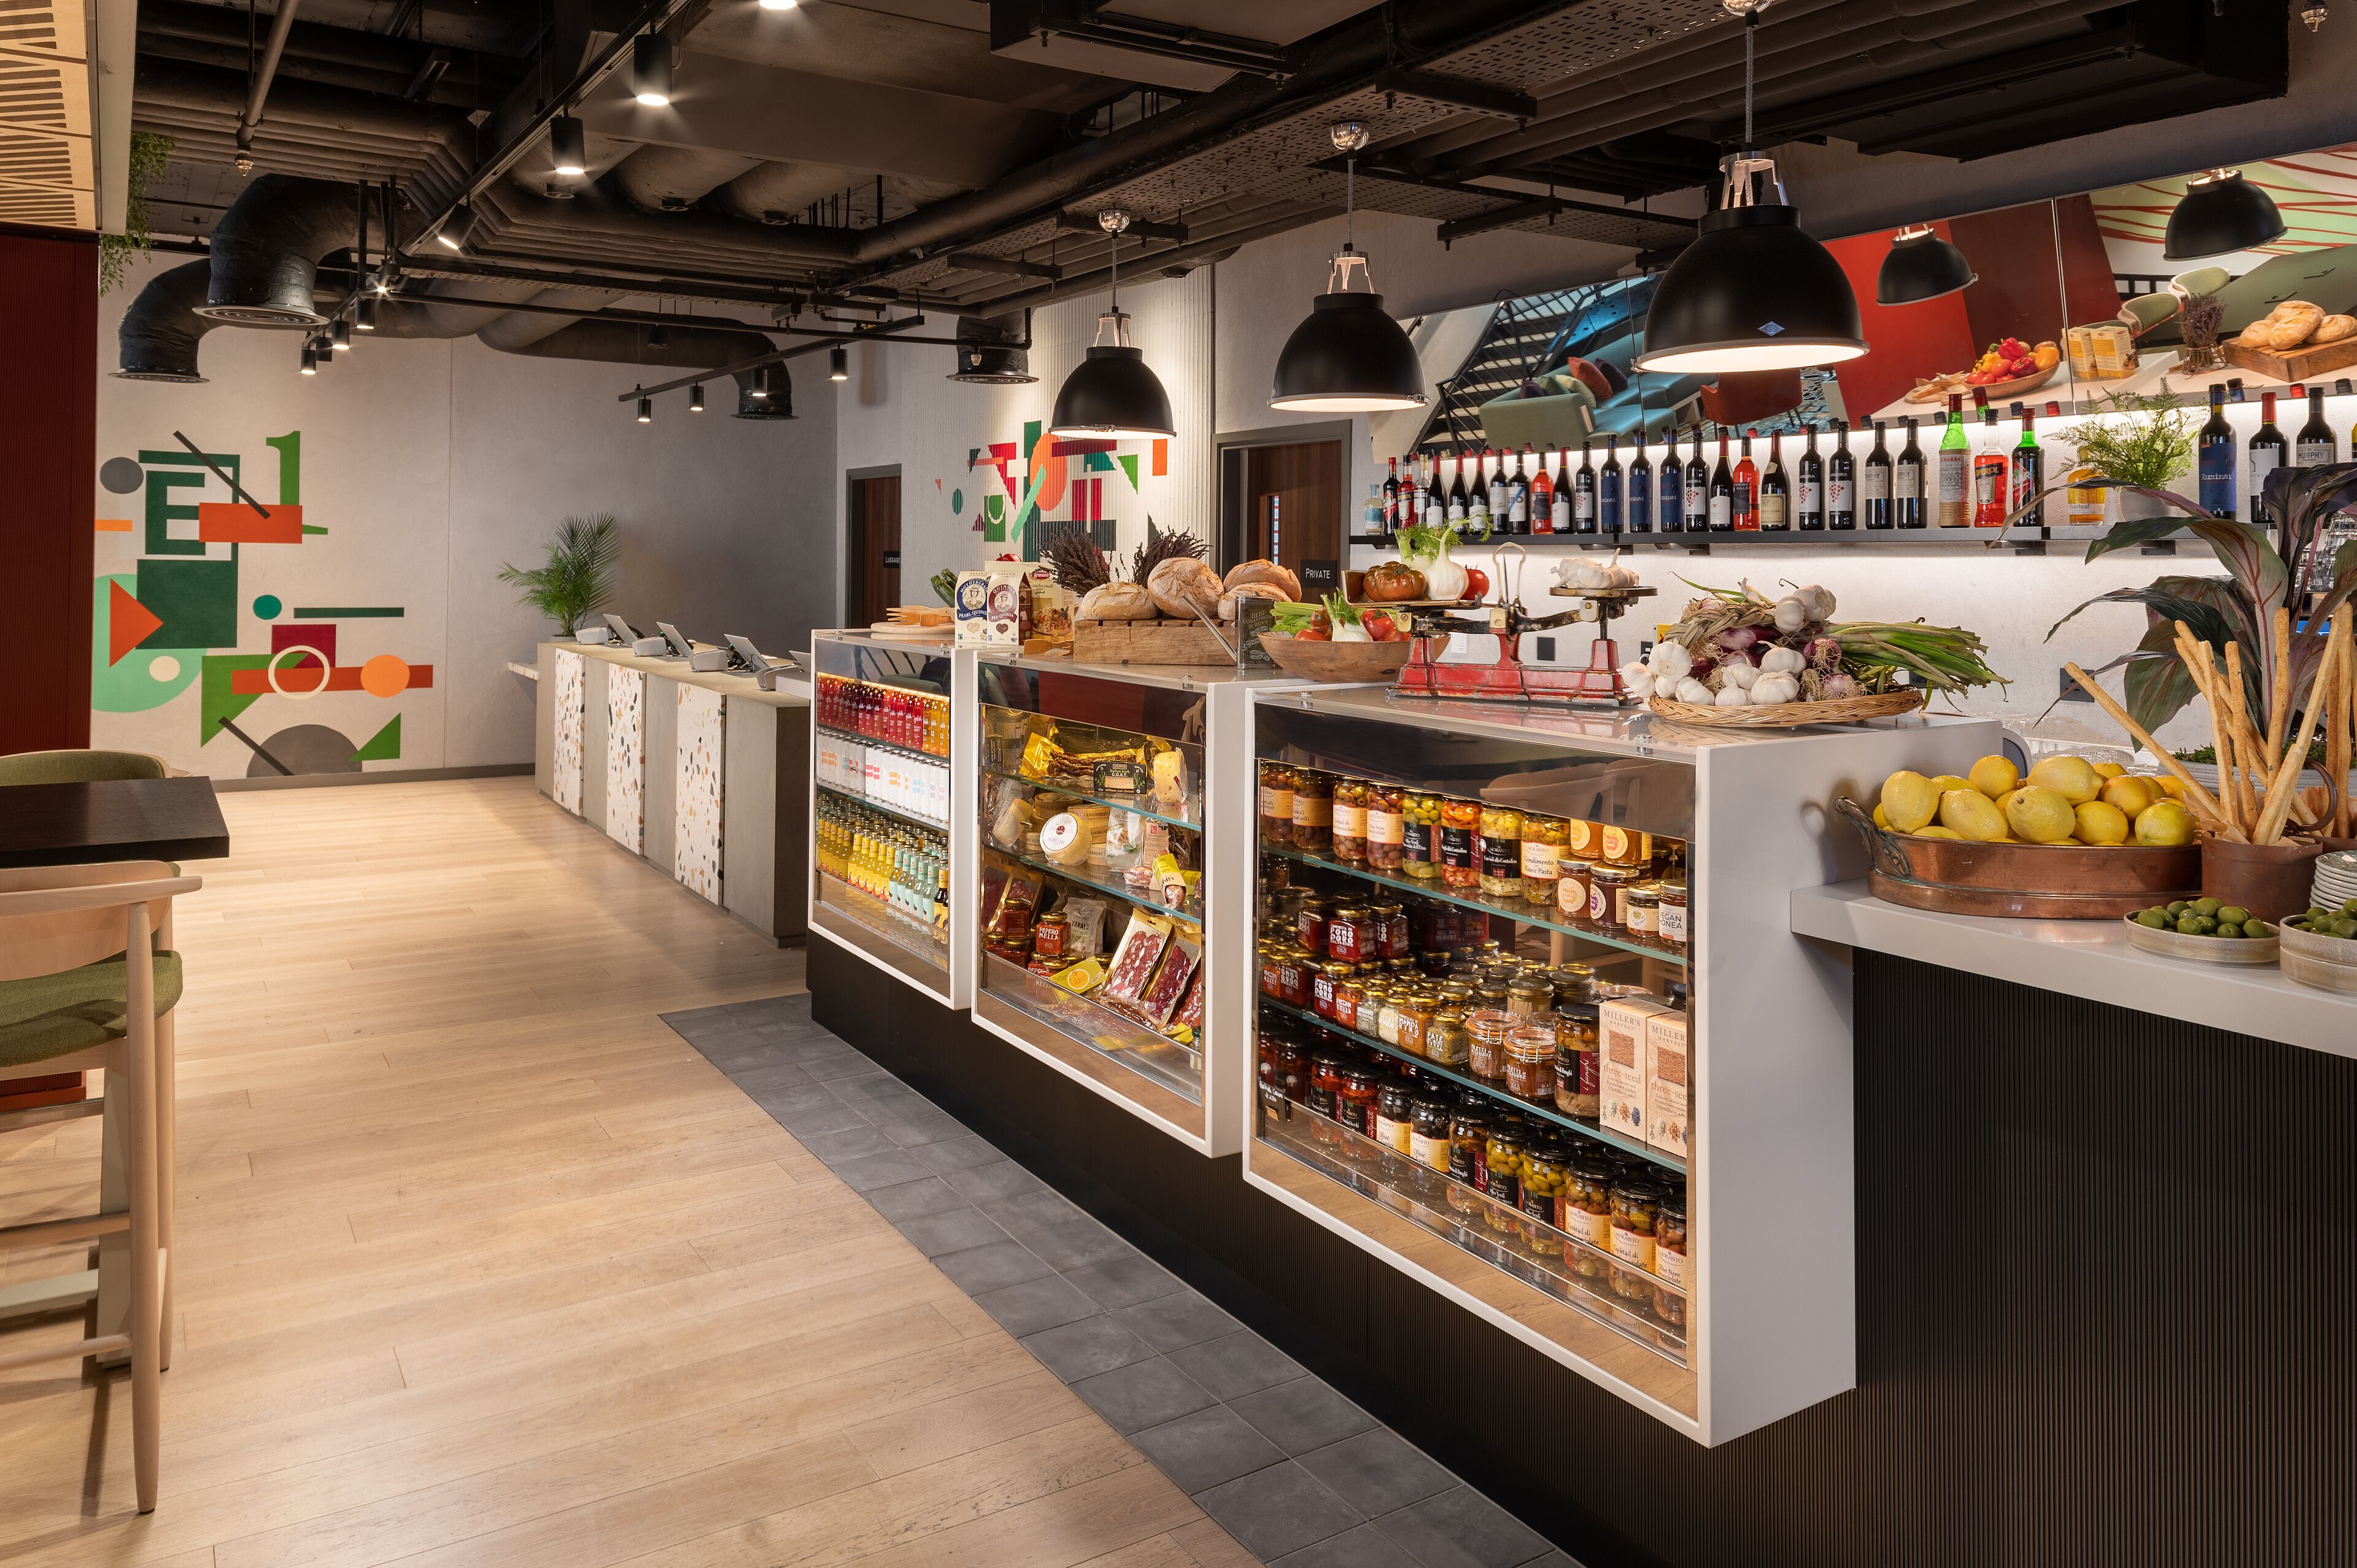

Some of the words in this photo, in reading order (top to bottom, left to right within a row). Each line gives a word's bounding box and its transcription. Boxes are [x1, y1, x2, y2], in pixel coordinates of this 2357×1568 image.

[1306, 568, 1330, 579] PRIVATE
[1252, 611, 1265, 619] OLIO
[1524, 855, 1554, 866] Condimento
[1660, 920, 1682, 929] ONEA
[1330, 928, 1354, 938] POMO
[1330, 933, 1354, 944] DORO
[1314, 981, 1333, 993] POMO
[1314, 987, 1333, 999] DORO
[1399, 1016, 1419, 1030] MANDA
[1604, 1010, 1641, 1027] MILLER'S
[1399, 1023, 1419, 1037] RINO
[1609, 1021, 1634, 1030] HARVEST
[1427, 1031, 1444, 1043] PATE
[1658, 1037, 1683, 1047] HARVEST
[1603, 1064, 1641, 1084] three-seed
[1651, 1082, 1687, 1101] three-see
[1379, 1131, 1390, 1141] Olive
[1414, 1148, 1426, 1158] Olive
[1569, 1210, 1592, 1222] MORABITO
[1568, 1222, 1584, 1235] Cocktail
[1615, 1231, 1639, 1244] MORABITO
[1613, 1244, 1631, 1258] Cocktail
[1659, 1250, 1684, 1264] MORABITO
[1658, 1263, 1668, 1275] Olive
[1668, 1269, 1681, 1278] Nere
